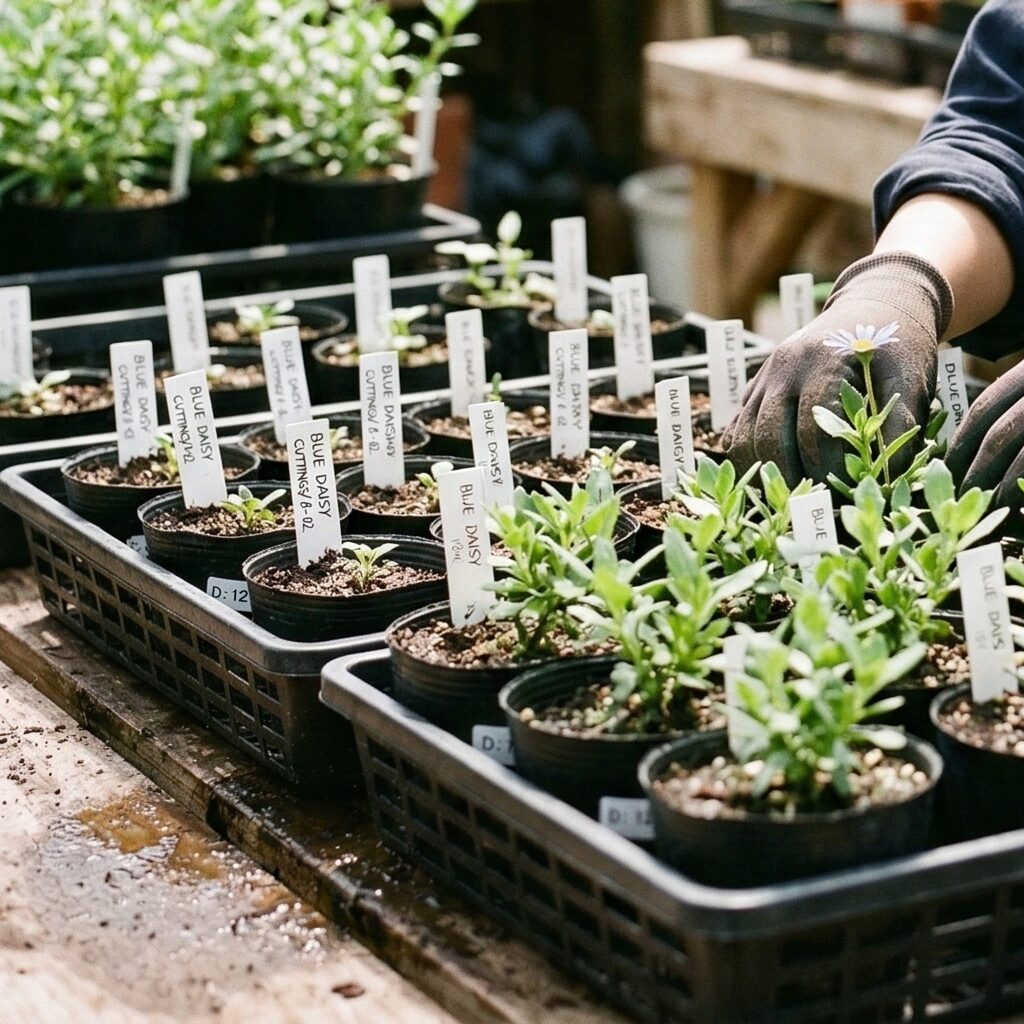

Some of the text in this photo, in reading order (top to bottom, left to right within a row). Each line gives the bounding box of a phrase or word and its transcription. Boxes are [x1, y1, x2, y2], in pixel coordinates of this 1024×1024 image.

[382, 365, 394, 399] BLUE
[190, 385, 214, 461] BLUE DAISY
[310, 432, 332, 518] BLUE DAISY
[488, 441, 504, 485] DAISY
[811, 508, 828, 541] BLUE
[465, 525, 482, 566] DAISY
[211, 585, 248, 603] D: 12
[980, 564, 998, 602] BLUE
